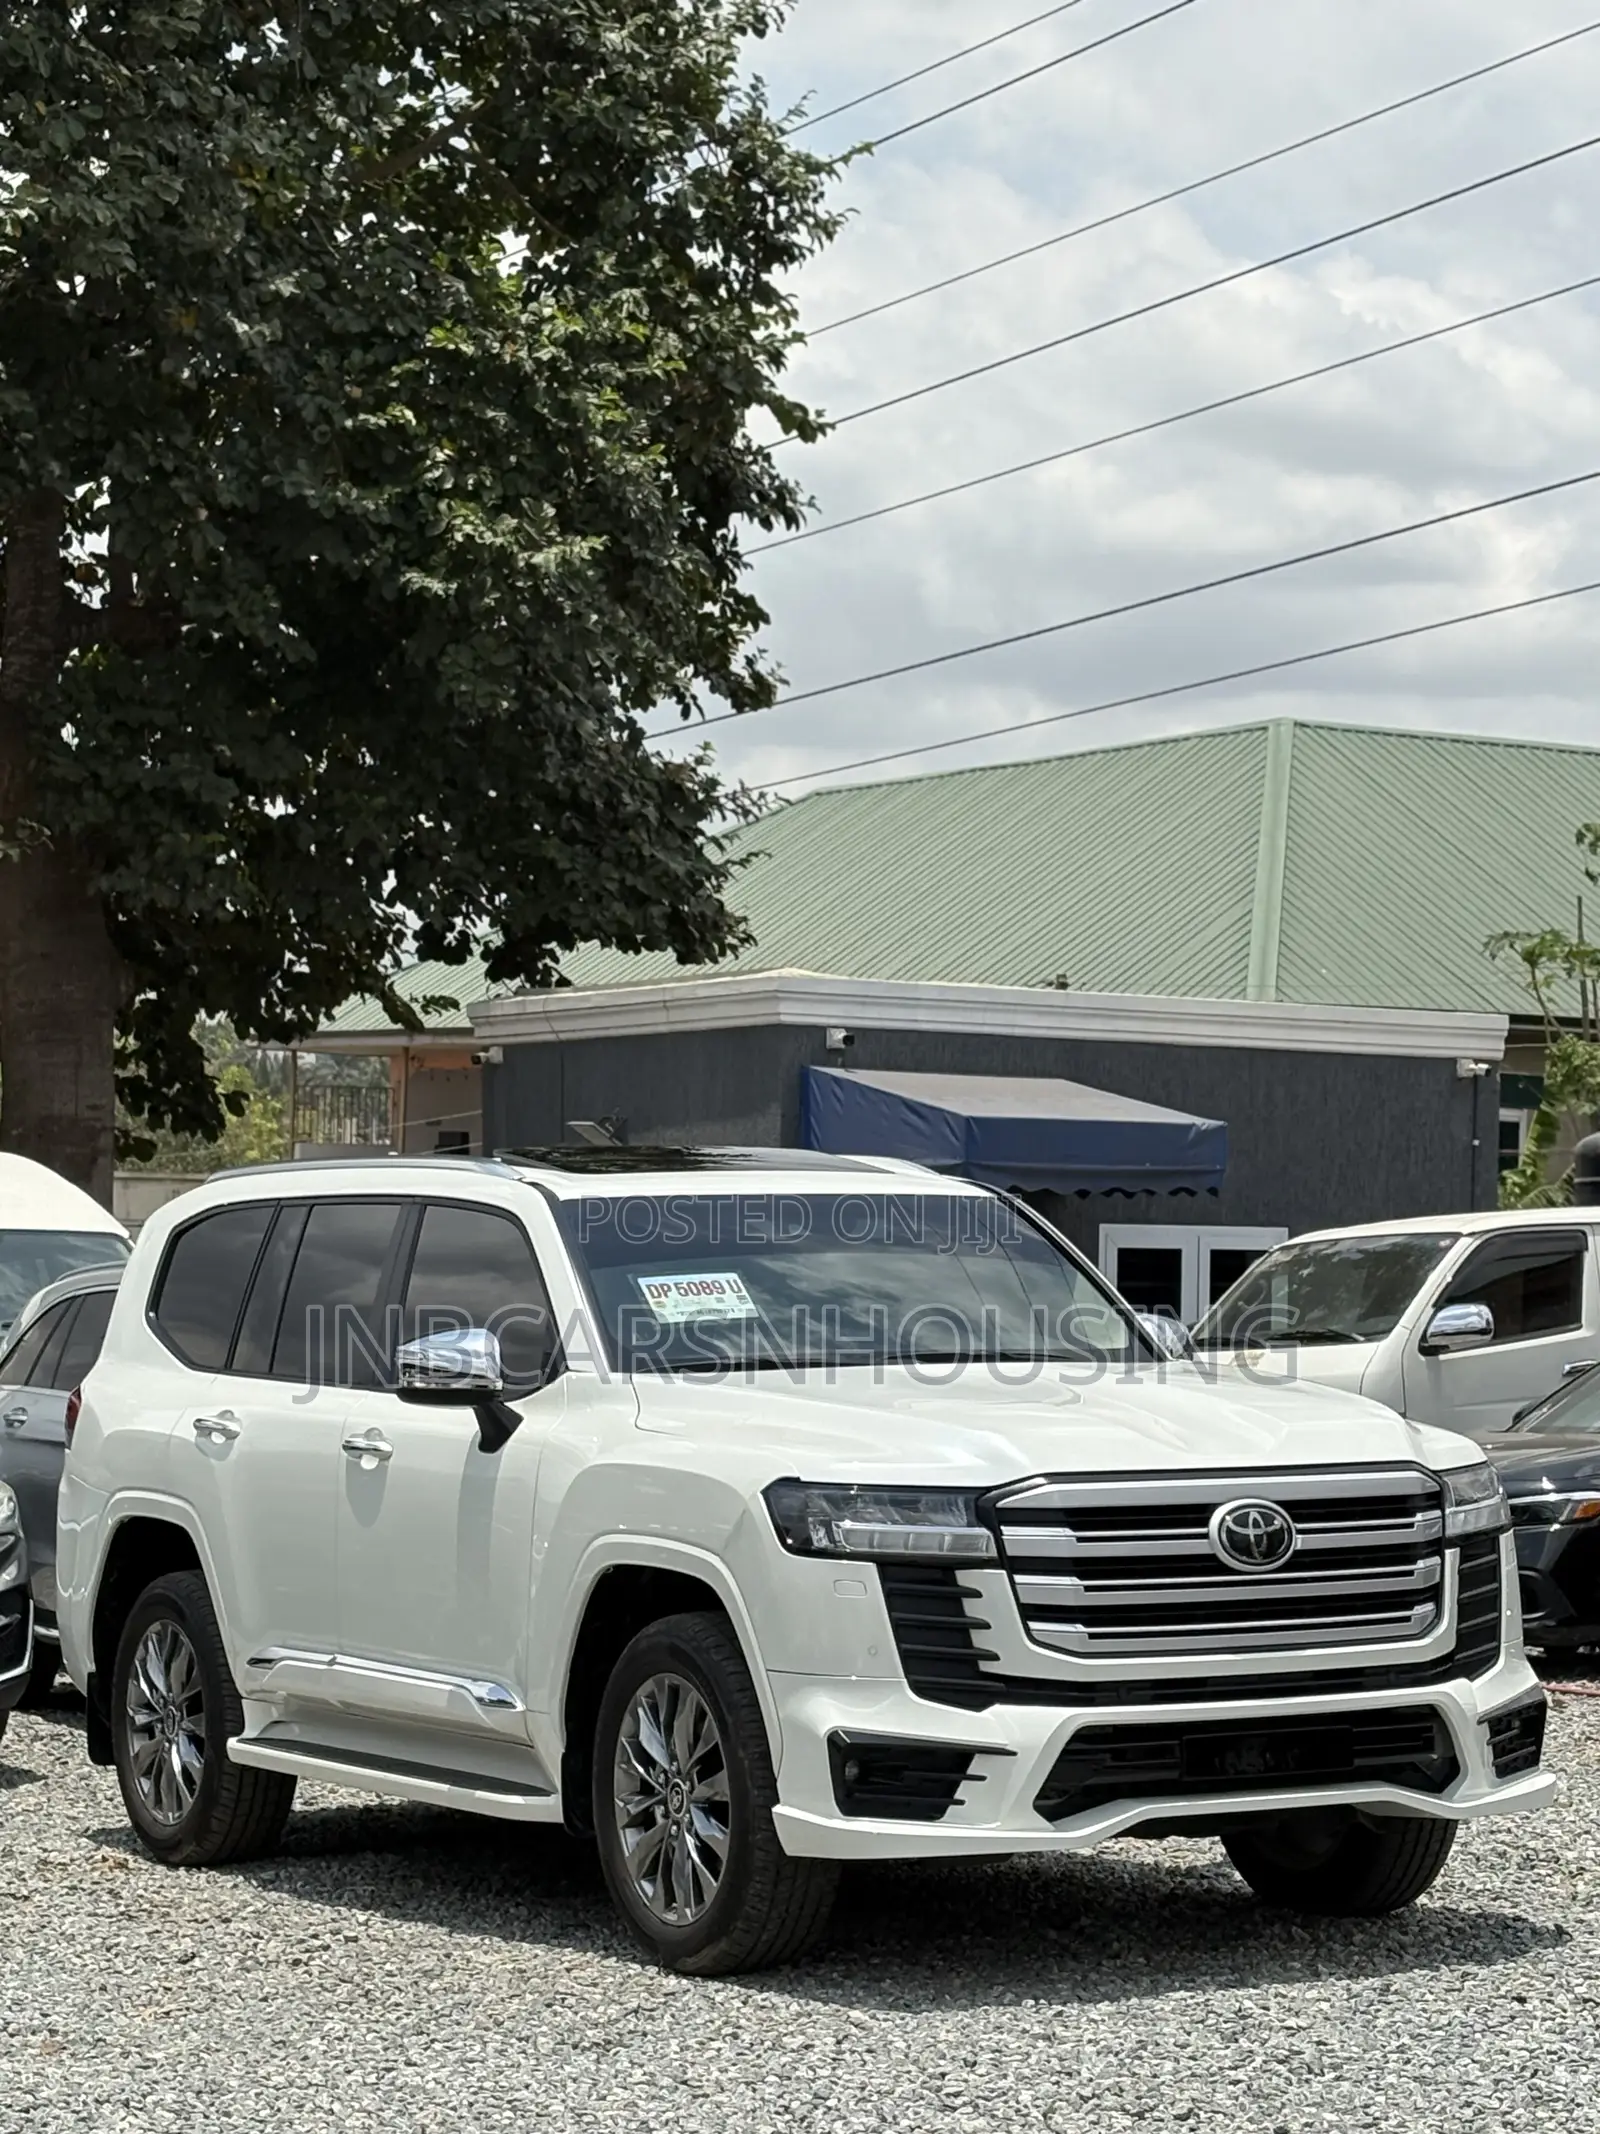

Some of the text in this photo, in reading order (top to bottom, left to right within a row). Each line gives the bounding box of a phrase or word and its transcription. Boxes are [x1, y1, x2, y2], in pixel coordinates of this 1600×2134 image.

[645, 1278, 743, 1300] DP 5089 U
